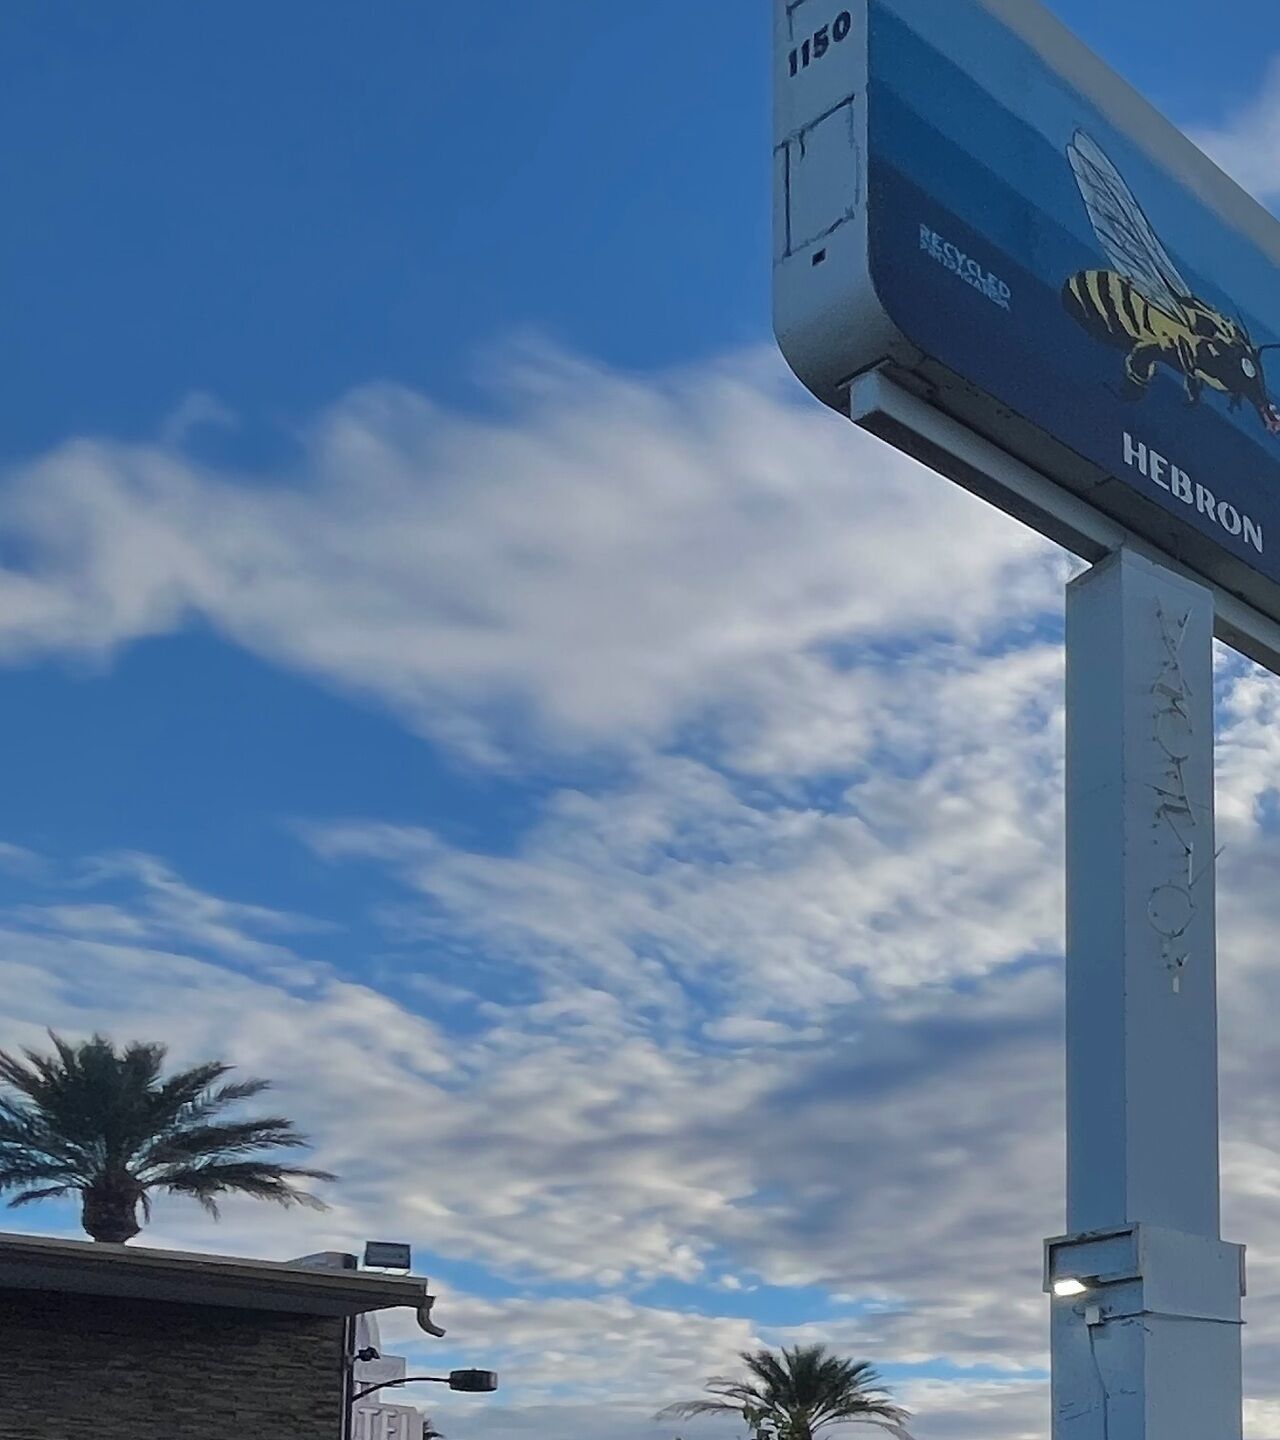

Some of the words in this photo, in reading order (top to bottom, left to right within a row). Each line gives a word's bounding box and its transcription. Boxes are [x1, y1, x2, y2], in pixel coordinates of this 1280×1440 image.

[788, 10, 851, 78] 1150
[920, 223, 1011, 300] RECYCLED
[1123, 431, 1263, 554] HEBRON
